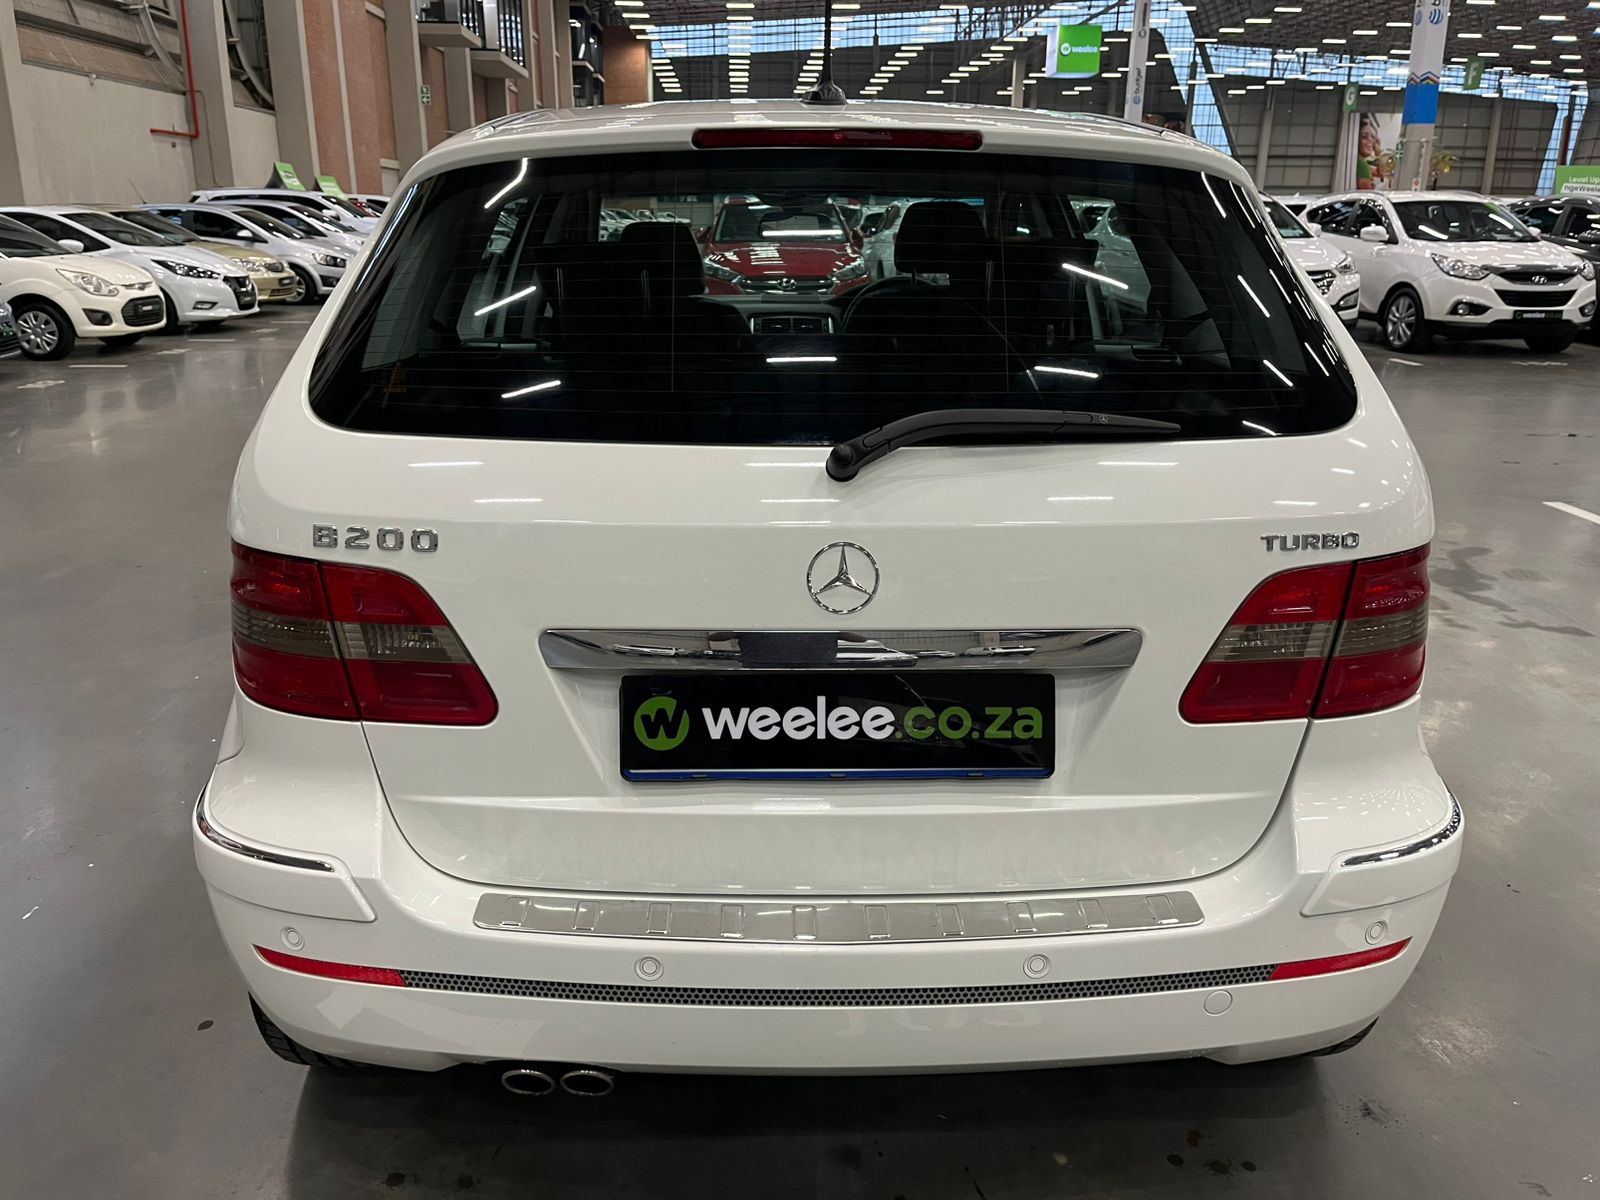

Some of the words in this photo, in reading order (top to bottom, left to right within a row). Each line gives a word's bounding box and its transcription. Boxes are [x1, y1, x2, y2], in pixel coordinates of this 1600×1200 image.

[1468, 62, 1479, 86] F
[1346, 86, 1356, 106] G
[312, 523, 439, 553] B200
[1260, 532, 1360, 552] TURBO
[702, 695, 1042, 741] weelee.co.za
